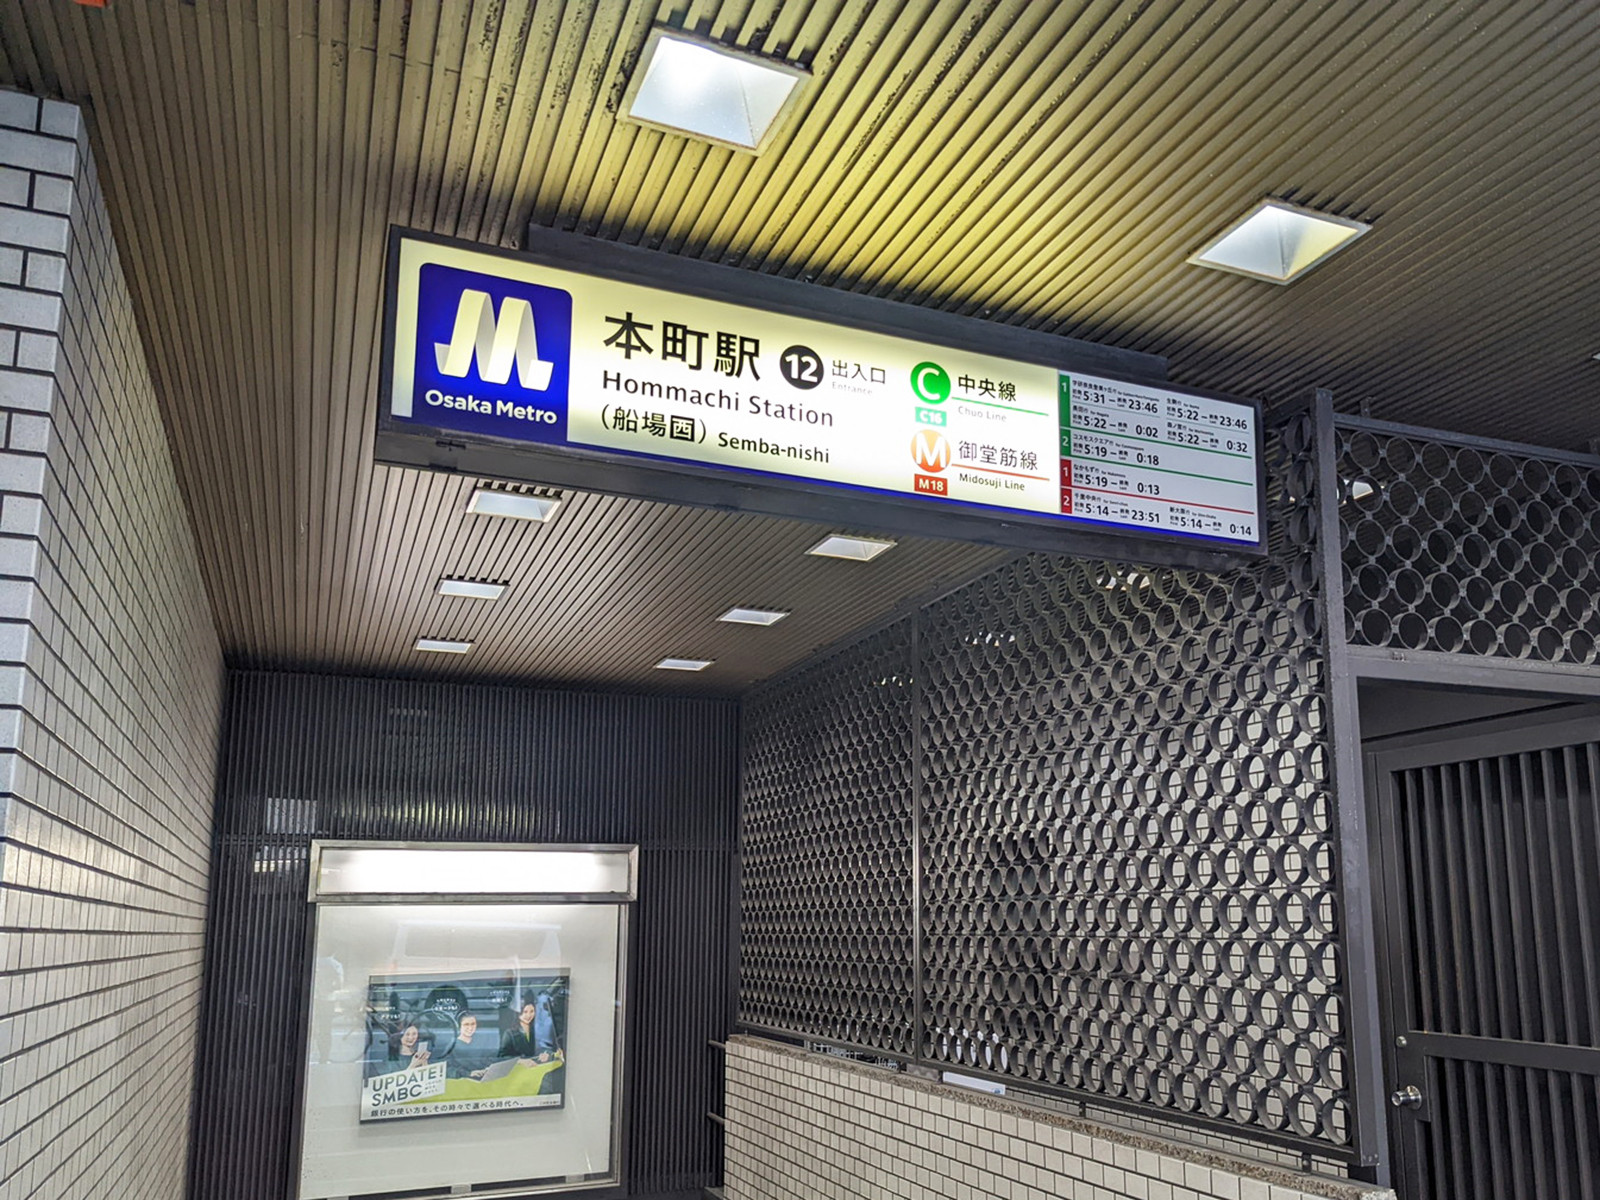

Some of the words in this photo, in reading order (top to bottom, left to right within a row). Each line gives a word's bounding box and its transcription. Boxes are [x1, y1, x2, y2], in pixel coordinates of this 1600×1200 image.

[603, 313, 761, 381] 本町駅
[784, 353, 819, 382] 12
[832, 360, 886, 384] 出入口
[832, 382, 873, 395] Entrance
[917, 366, 940, 401] C
[958, 374, 1016, 401] 中央線
[425, 390, 492, 415] Osaka
[496, 401, 557, 424] Metro
[603, 370, 739, 412] Hommachi
[749, 397, 833, 427] Station
[1083, 391, 1105, 404] 5:31
[1128, 399, 1158, 413] 23:46
[919, 409, 943, 424] C16
[958, 406, 983, 418] Chuo
[986, 411, 1007, 422] Line
[1177, 408, 1199, 421] 5:22
[1219, 416, 1247, 430] 23:46
[1083, 416, 1106, 429] 5:22
[1136, 425, 1158, 438] 0:02
[719, 432, 830, 463] Semba-nishi
[915, 433, 947, 467] M
[1178, 433, 1199, 445] 5:22
[1226, 440, 1248, 452] 0:32
[959, 440, 1038, 471] 御堂筋線
[1084, 445, 1107, 457] 5:19
[1136, 453, 1159, 466] 0:18
[919, 478, 943, 492] M18
[959, 473, 1002, 489] Midosuji
[1005, 480, 1025, 491] Line
[1085, 475, 1108, 487] 5:19
[1137, 483, 1160, 495] 0:13
[1085, 504, 1109, 516] 5:14
[1132, 510, 1160, 523] 23:51
[1180, 517, 1202, 529] 5:14
[1230, 524, 1251, 536] 0:14
[372, 1065, 444, 1092] UPDATE!
[371, 1085, 422, 1107] SMBC
